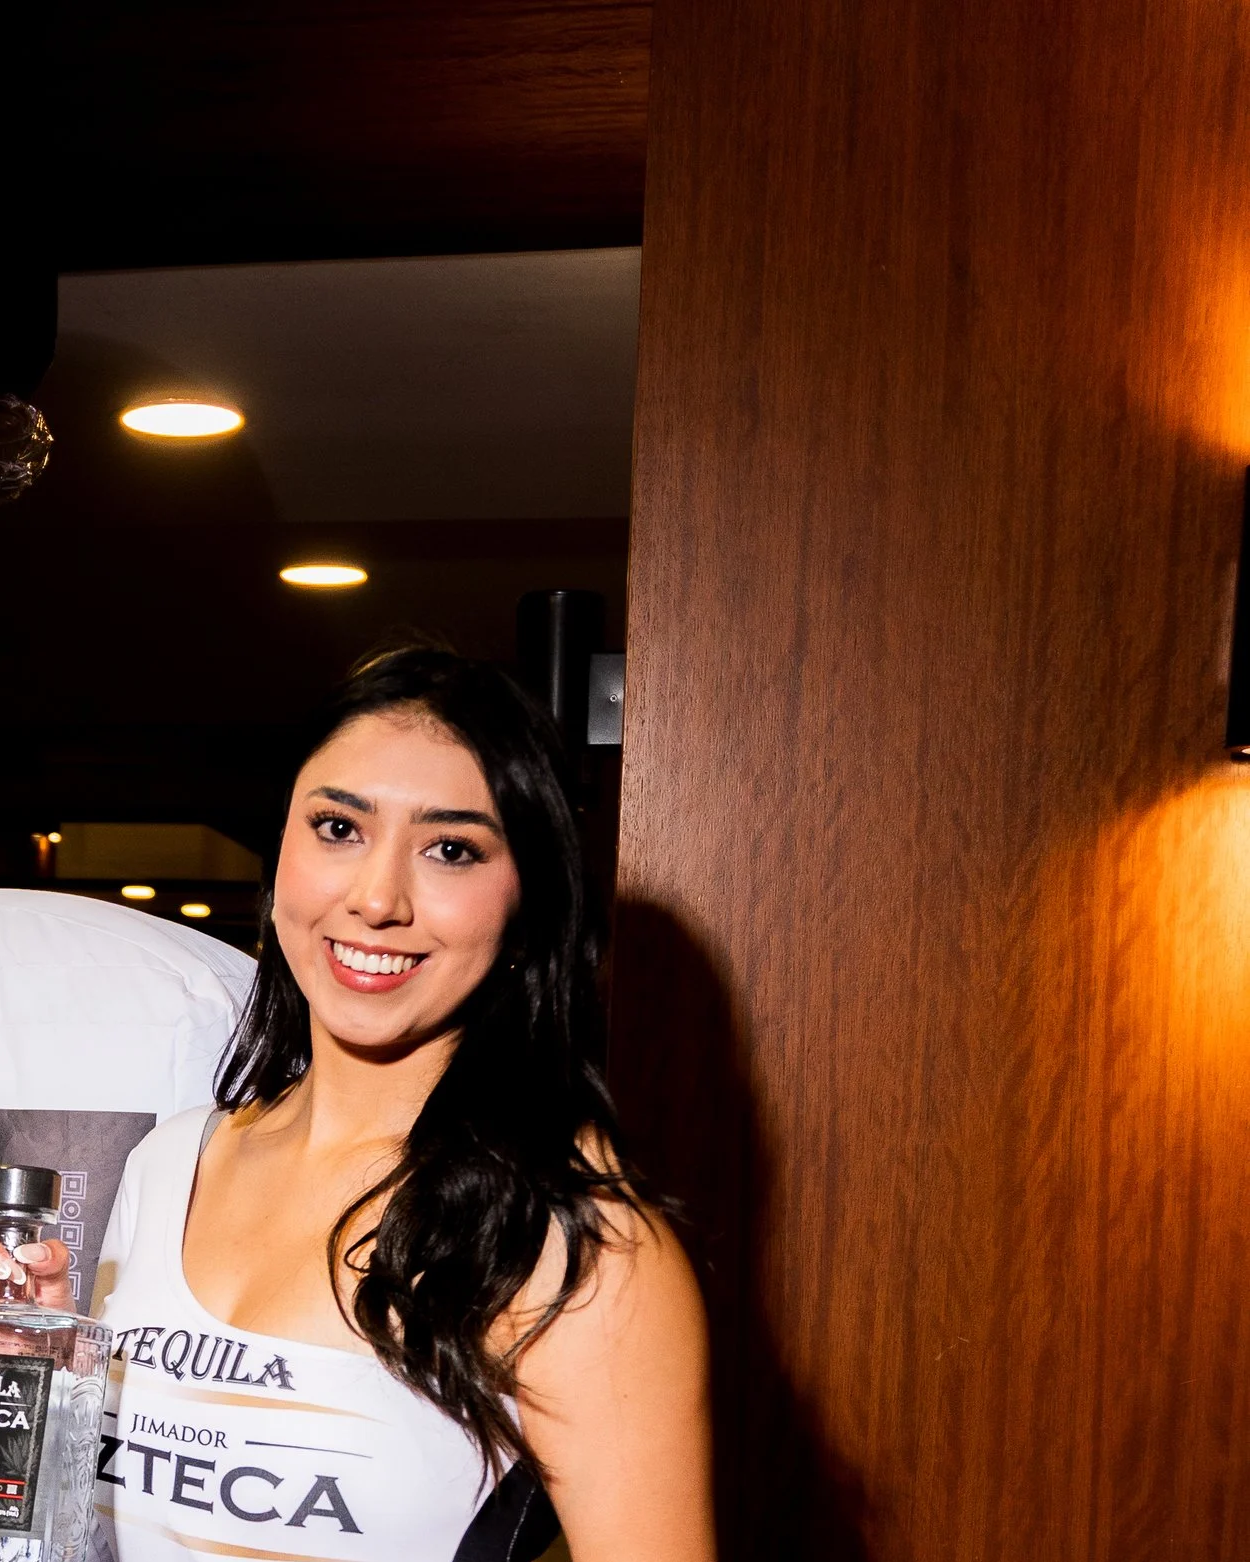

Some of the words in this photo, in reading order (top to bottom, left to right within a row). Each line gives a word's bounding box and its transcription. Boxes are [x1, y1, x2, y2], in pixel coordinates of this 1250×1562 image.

[112, 1327, 296, 1391] TEQUILA
[130, 1413, 229, 1449] JIMADOR
[96, 1434, 364, 1534] ZTECA
